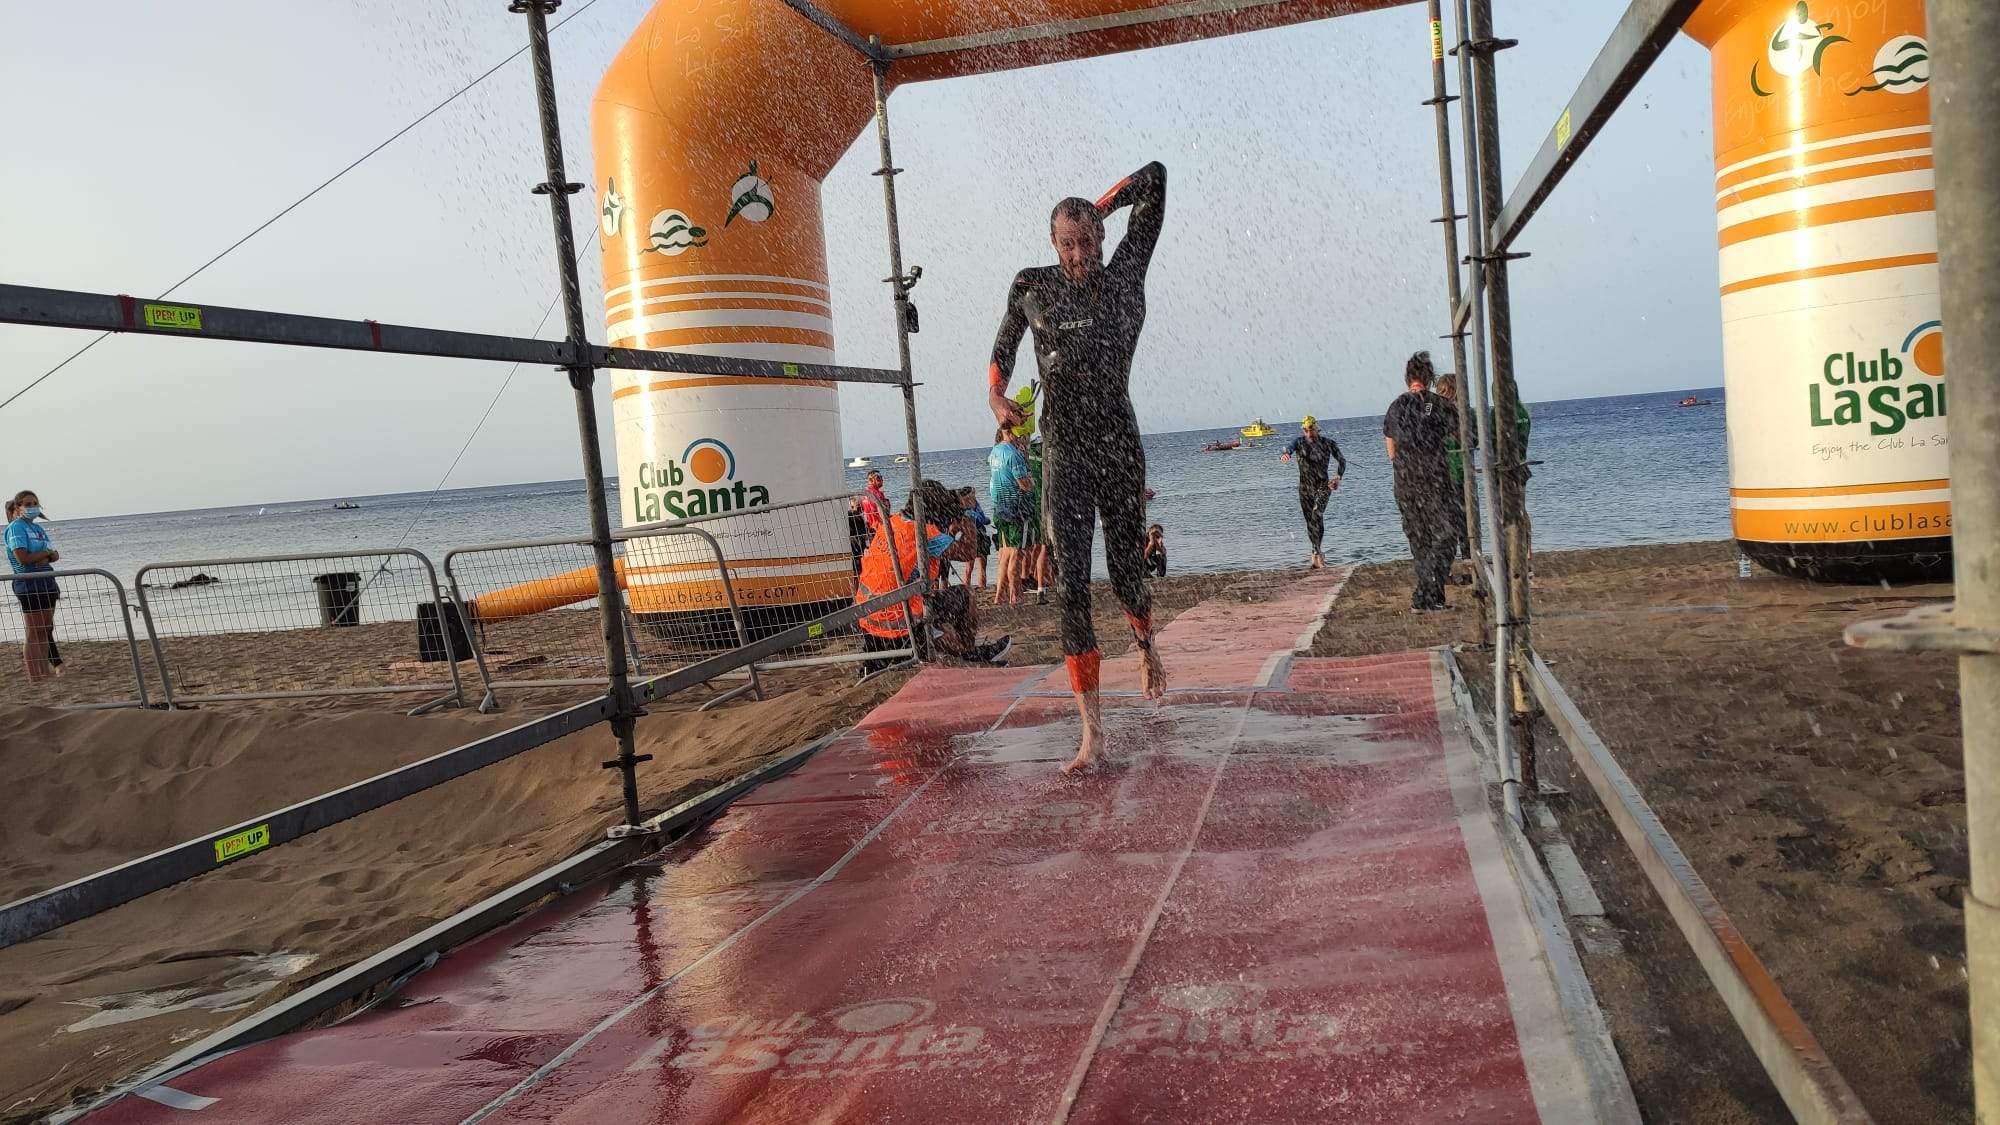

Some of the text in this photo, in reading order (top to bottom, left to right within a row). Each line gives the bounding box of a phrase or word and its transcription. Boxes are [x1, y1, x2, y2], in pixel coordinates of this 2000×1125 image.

[180, 311, 196, 323] UP
[1824, 348, 1903, 386] Club
[1812, 443, 1843, 461] Enjoy
[1850, 440, 1870, 452] the
[1877, 437, 1904, 449] Club
[1911, 436, 1926, 447] La
[639, 460, 684, 489] Club
[633, 480, 770, 523] LaSanta
[247, 830, 264, 845] UP
